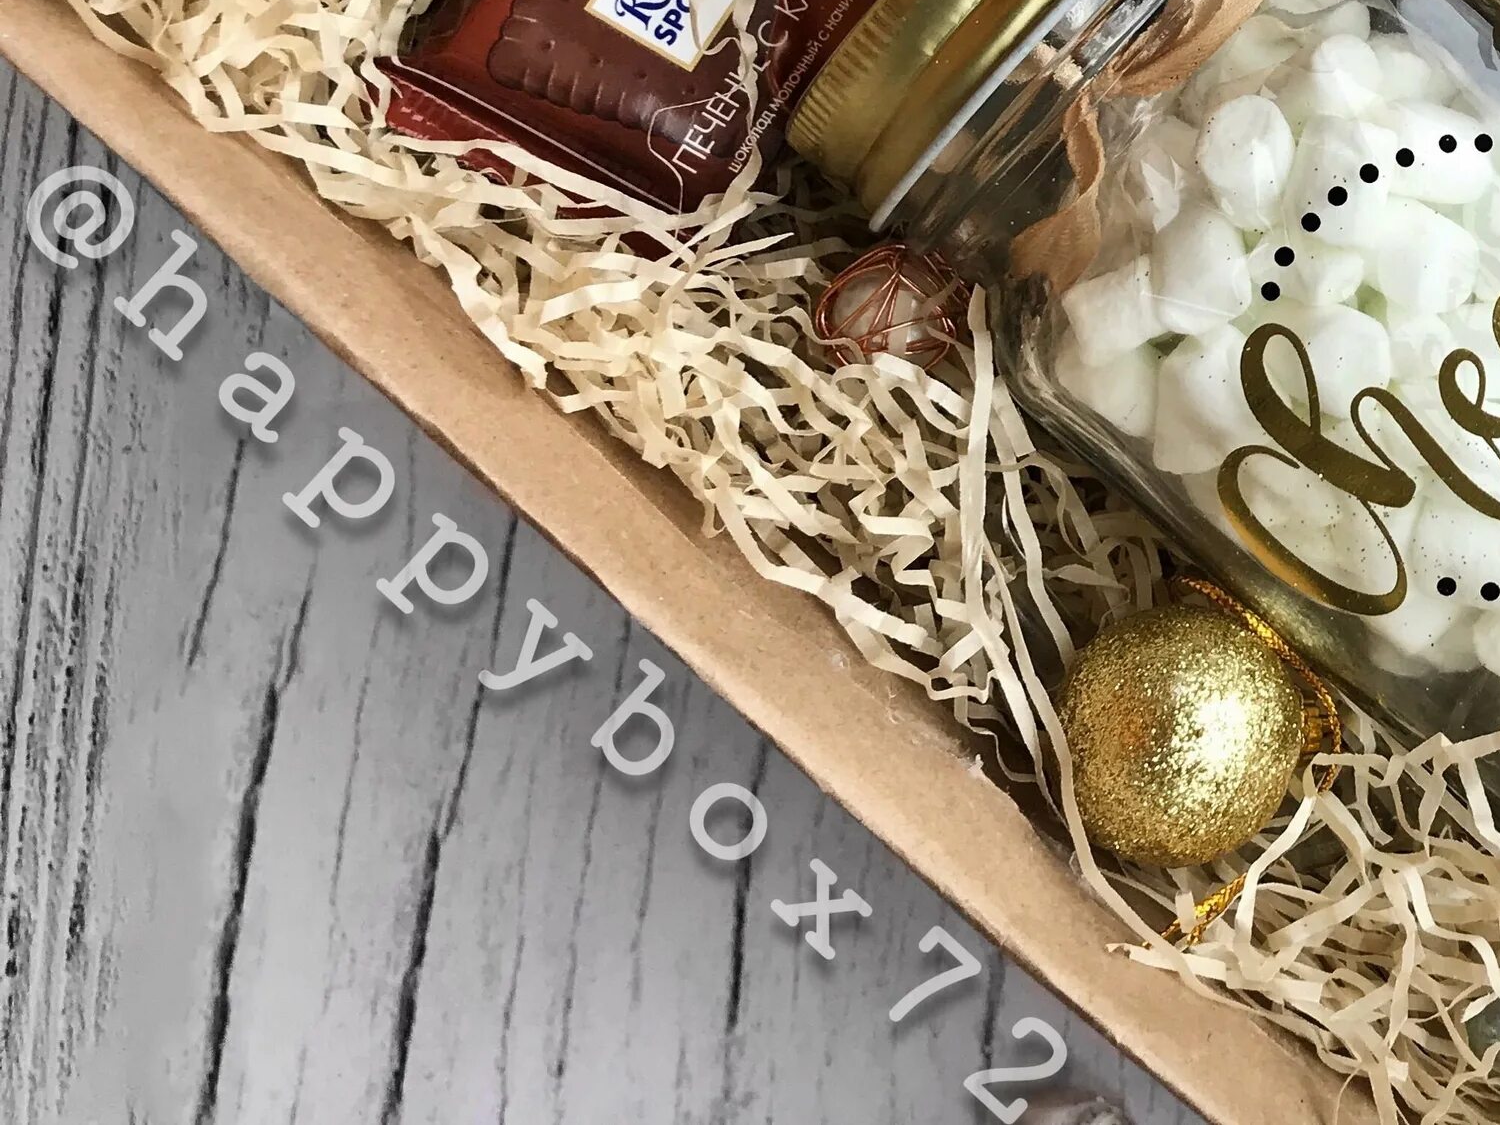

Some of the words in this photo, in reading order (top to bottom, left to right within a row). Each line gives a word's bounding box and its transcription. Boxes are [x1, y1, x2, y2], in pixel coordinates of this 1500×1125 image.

[757, 19, 789, 48] С
[728, 106, 777, 174] шоколад
[768, 39, 822, 113] молочный
